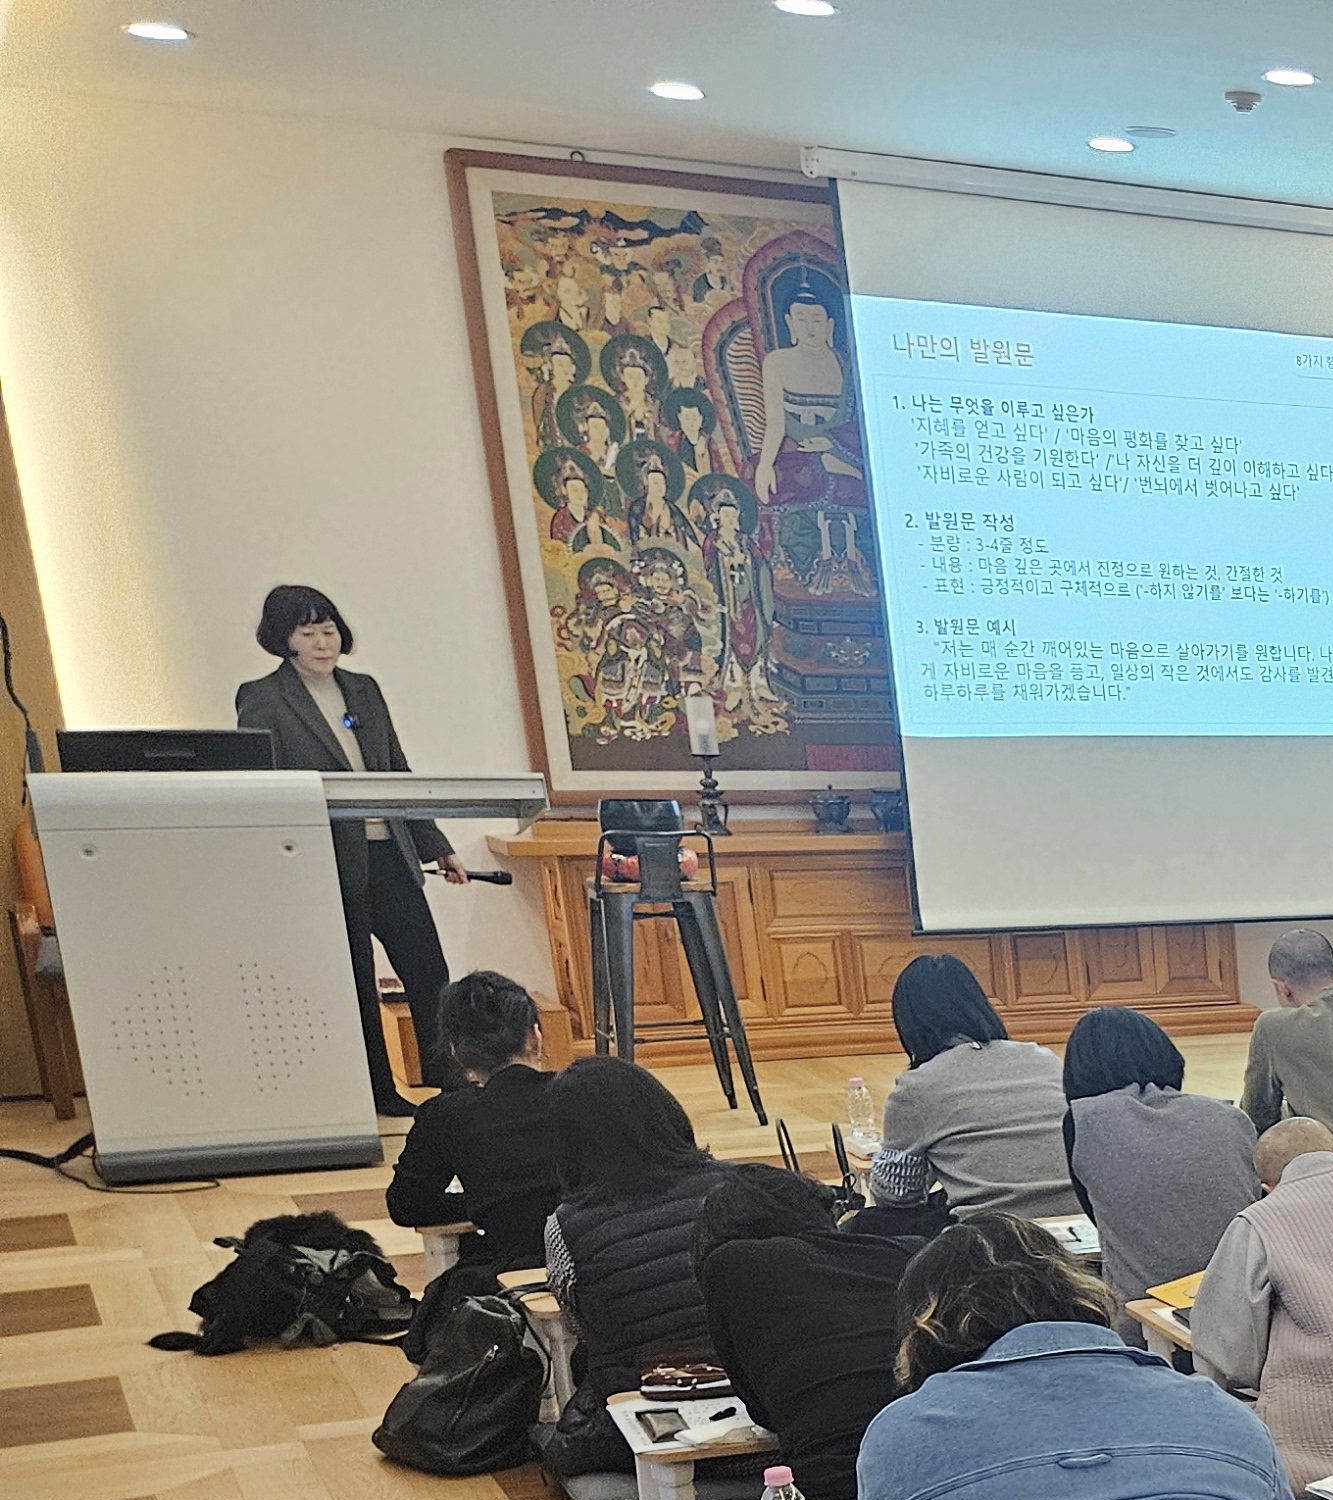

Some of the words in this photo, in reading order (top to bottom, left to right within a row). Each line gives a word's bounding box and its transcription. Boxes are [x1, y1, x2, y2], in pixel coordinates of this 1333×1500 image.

[892, 331, 960, 361] 나만의
[969, 338, 1035, 367] 발원문
[911, 393, 943, 414] 나는
[948, 396, 995, 417] 무엇을
[1000, 400, 1045, 420] 이루고
[1050, 403, 1095, 424] 싶은가
[1122, 429, 1168, 450] 평화를
[1173, 433, 1204, 452] 찾고
[977, 444, 1027, 465] 건강을
[1136, 453, 1181, 474] 자신을
[1187, 456, 1201, 475] 더
[1207, 458, 1236, 477] 깊이
[1242, 460, 1301, 480] 이해하고
[995, 468, 1045, 489] 사람이
[1050, 471, 1082, 491] 되고
[1204, 480, 1264, 501] 벗어나고
[924, 511, 977, 531] 발원문
[982, 513, 1015, 532] 작성
[1018, 537, 1049, 555] 정도
[931, 554, 963, 573] 내용
[978, 556, 1008, 574] 마음
[1014, 557, 1043, 576] 깊은
[1047, 558, 1092, 577] 곳에서
[1157, 562, 1198, 581] 원하는
[1270, 566, 1283, 583] 것
[1230, 585, 1270, 602] 보다는
[933, 617, 980, 635] 발원문
[985, 618, 1017, 636] 예시
[1003, 639, 1035, 658] 순간
[1041, 640, 1104, 659] 깨어있는
[1319, 645, 1333, 663] 나
[942, 662, 1011, 680] 자비로운
[1016, 663, 1064, 681] 마음을
[1110, 664, 1155, 682] 일상의
[1160, 665, 1190, 682] 작은
